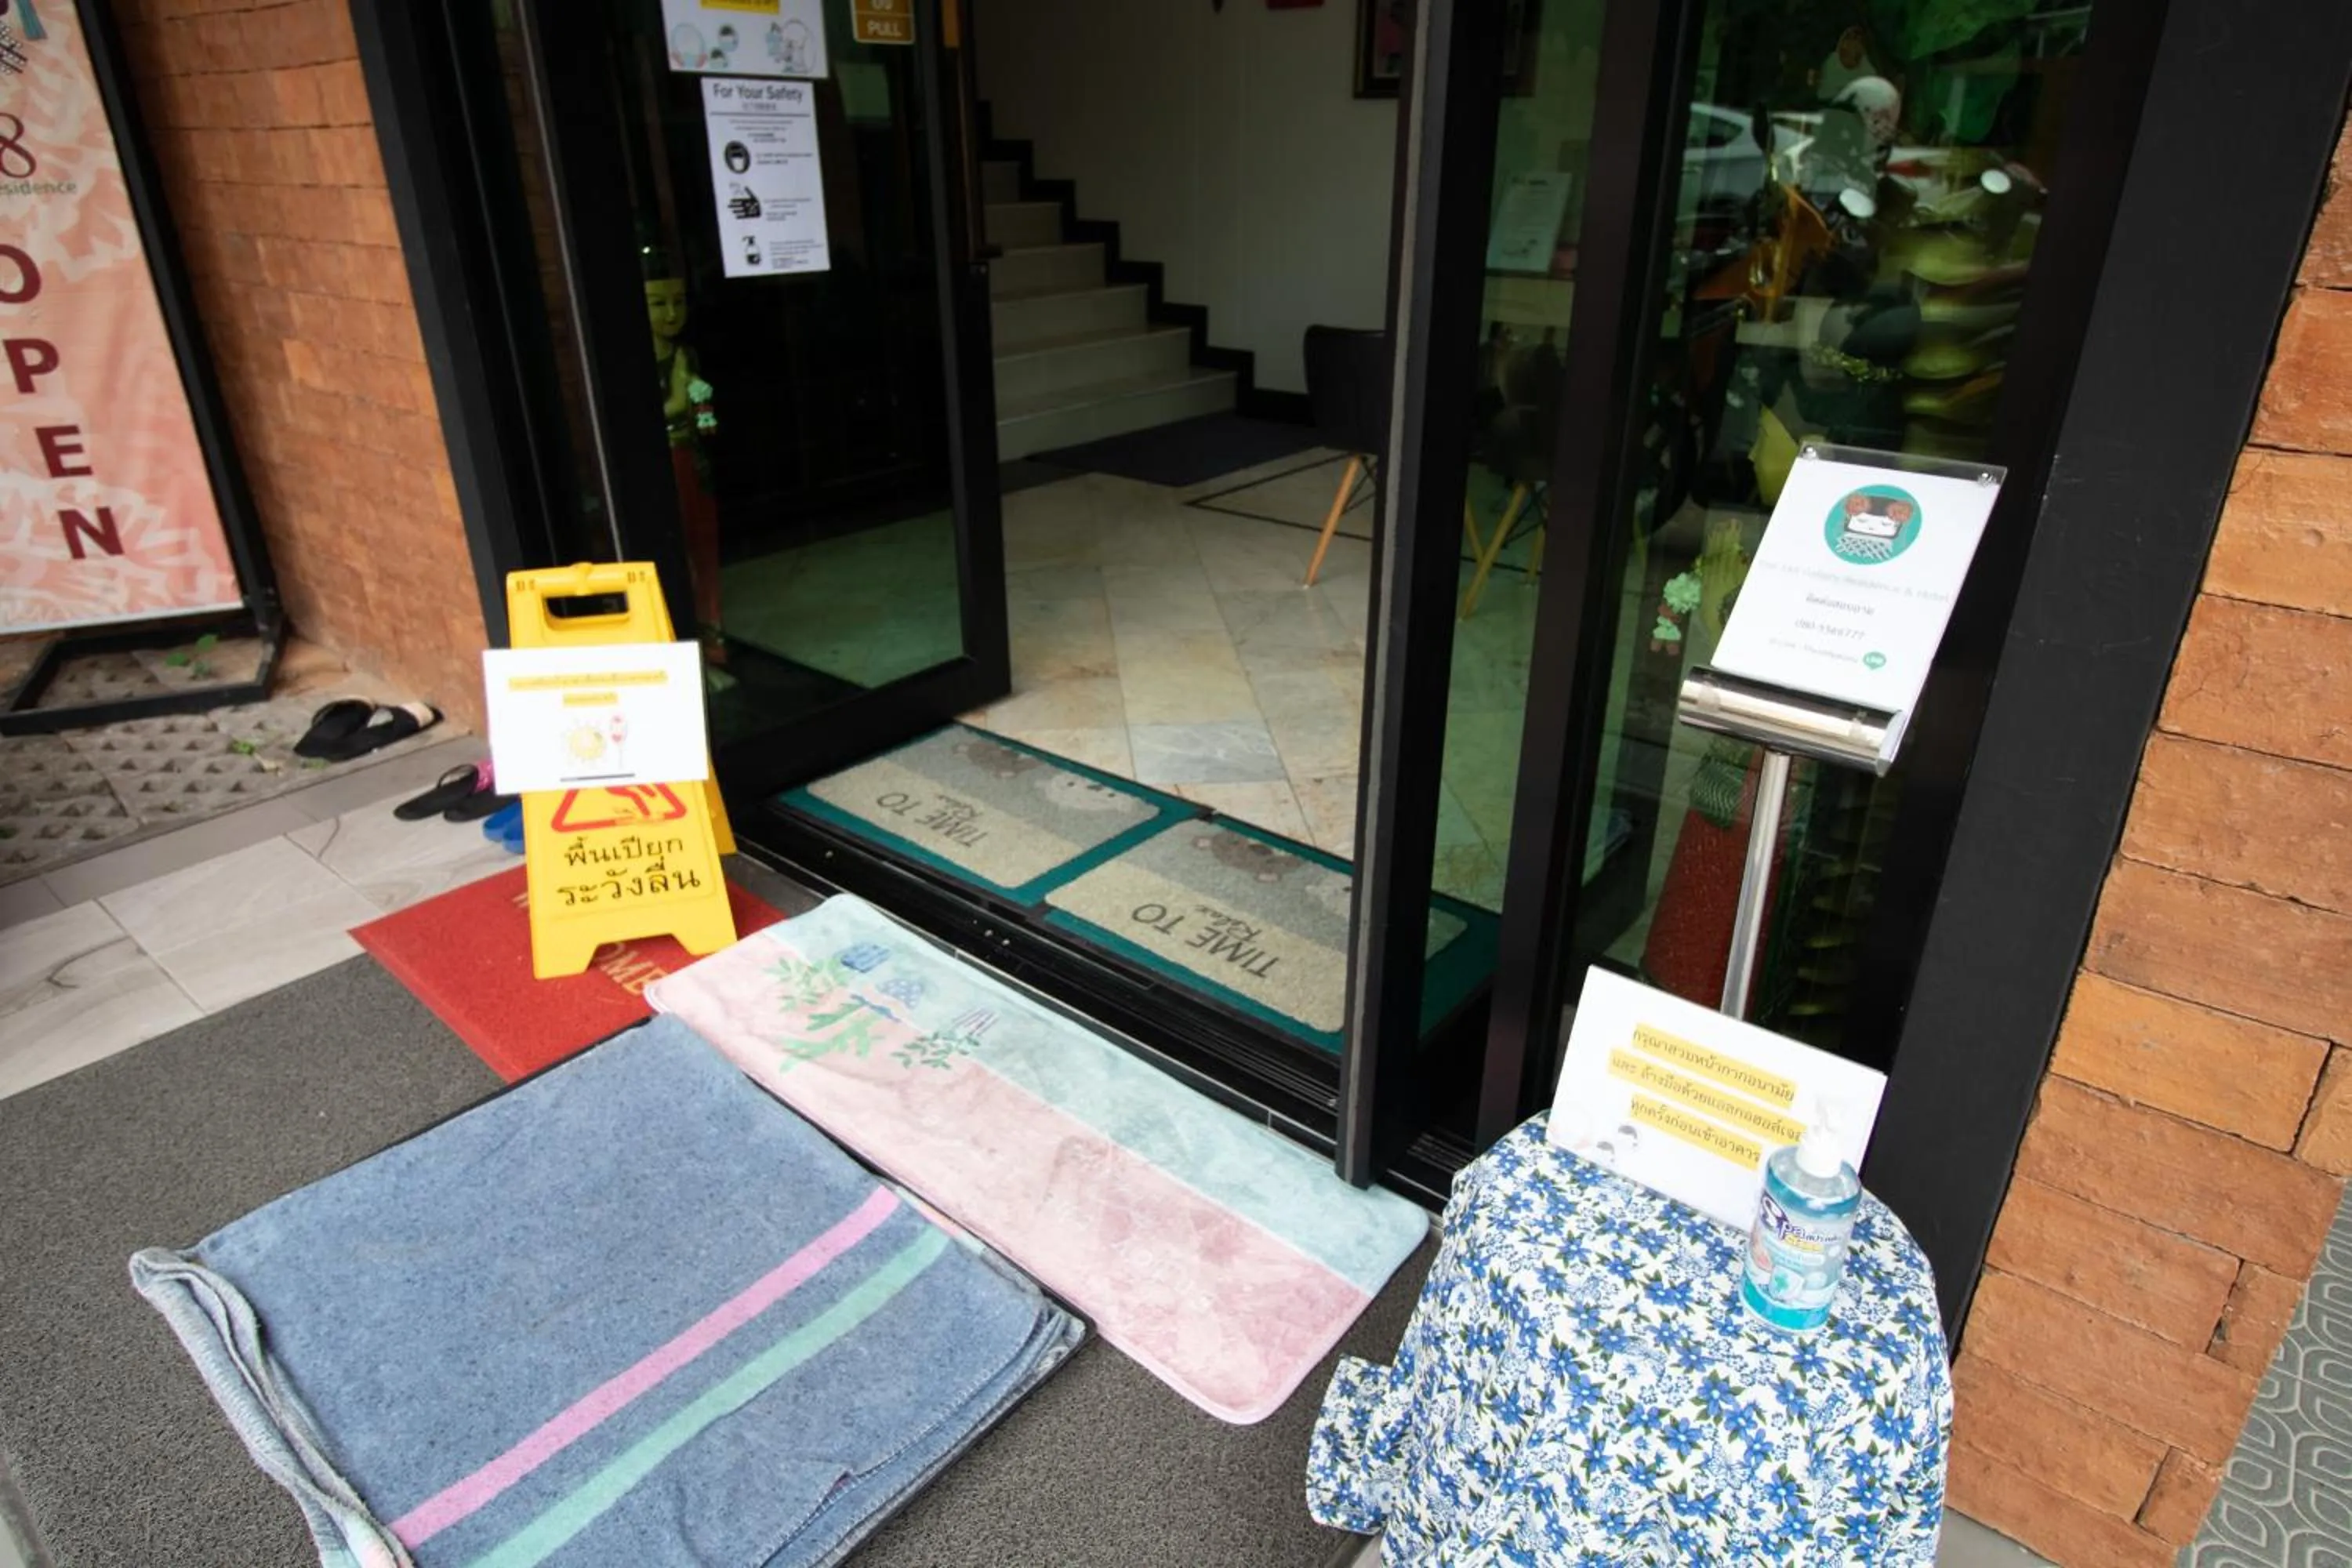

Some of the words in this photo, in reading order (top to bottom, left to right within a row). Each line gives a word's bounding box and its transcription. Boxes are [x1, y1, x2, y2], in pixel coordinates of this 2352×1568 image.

[867, 20, 903, 38] PULL
[713, 82, 733, 99] For
[736, 85, 764, 100] Your
[765, 85, 803, 104] Safety
[876, 792, 923, 817] TO
[914, 811, 989, 848] TIME
[564, 834, 684, 866] พื้นเปียก
[557, 855, 702, 906] ระวังลื่น
[1131, 902, 1185, 935] TO
[1184, 926, 1280, 979] TIME
